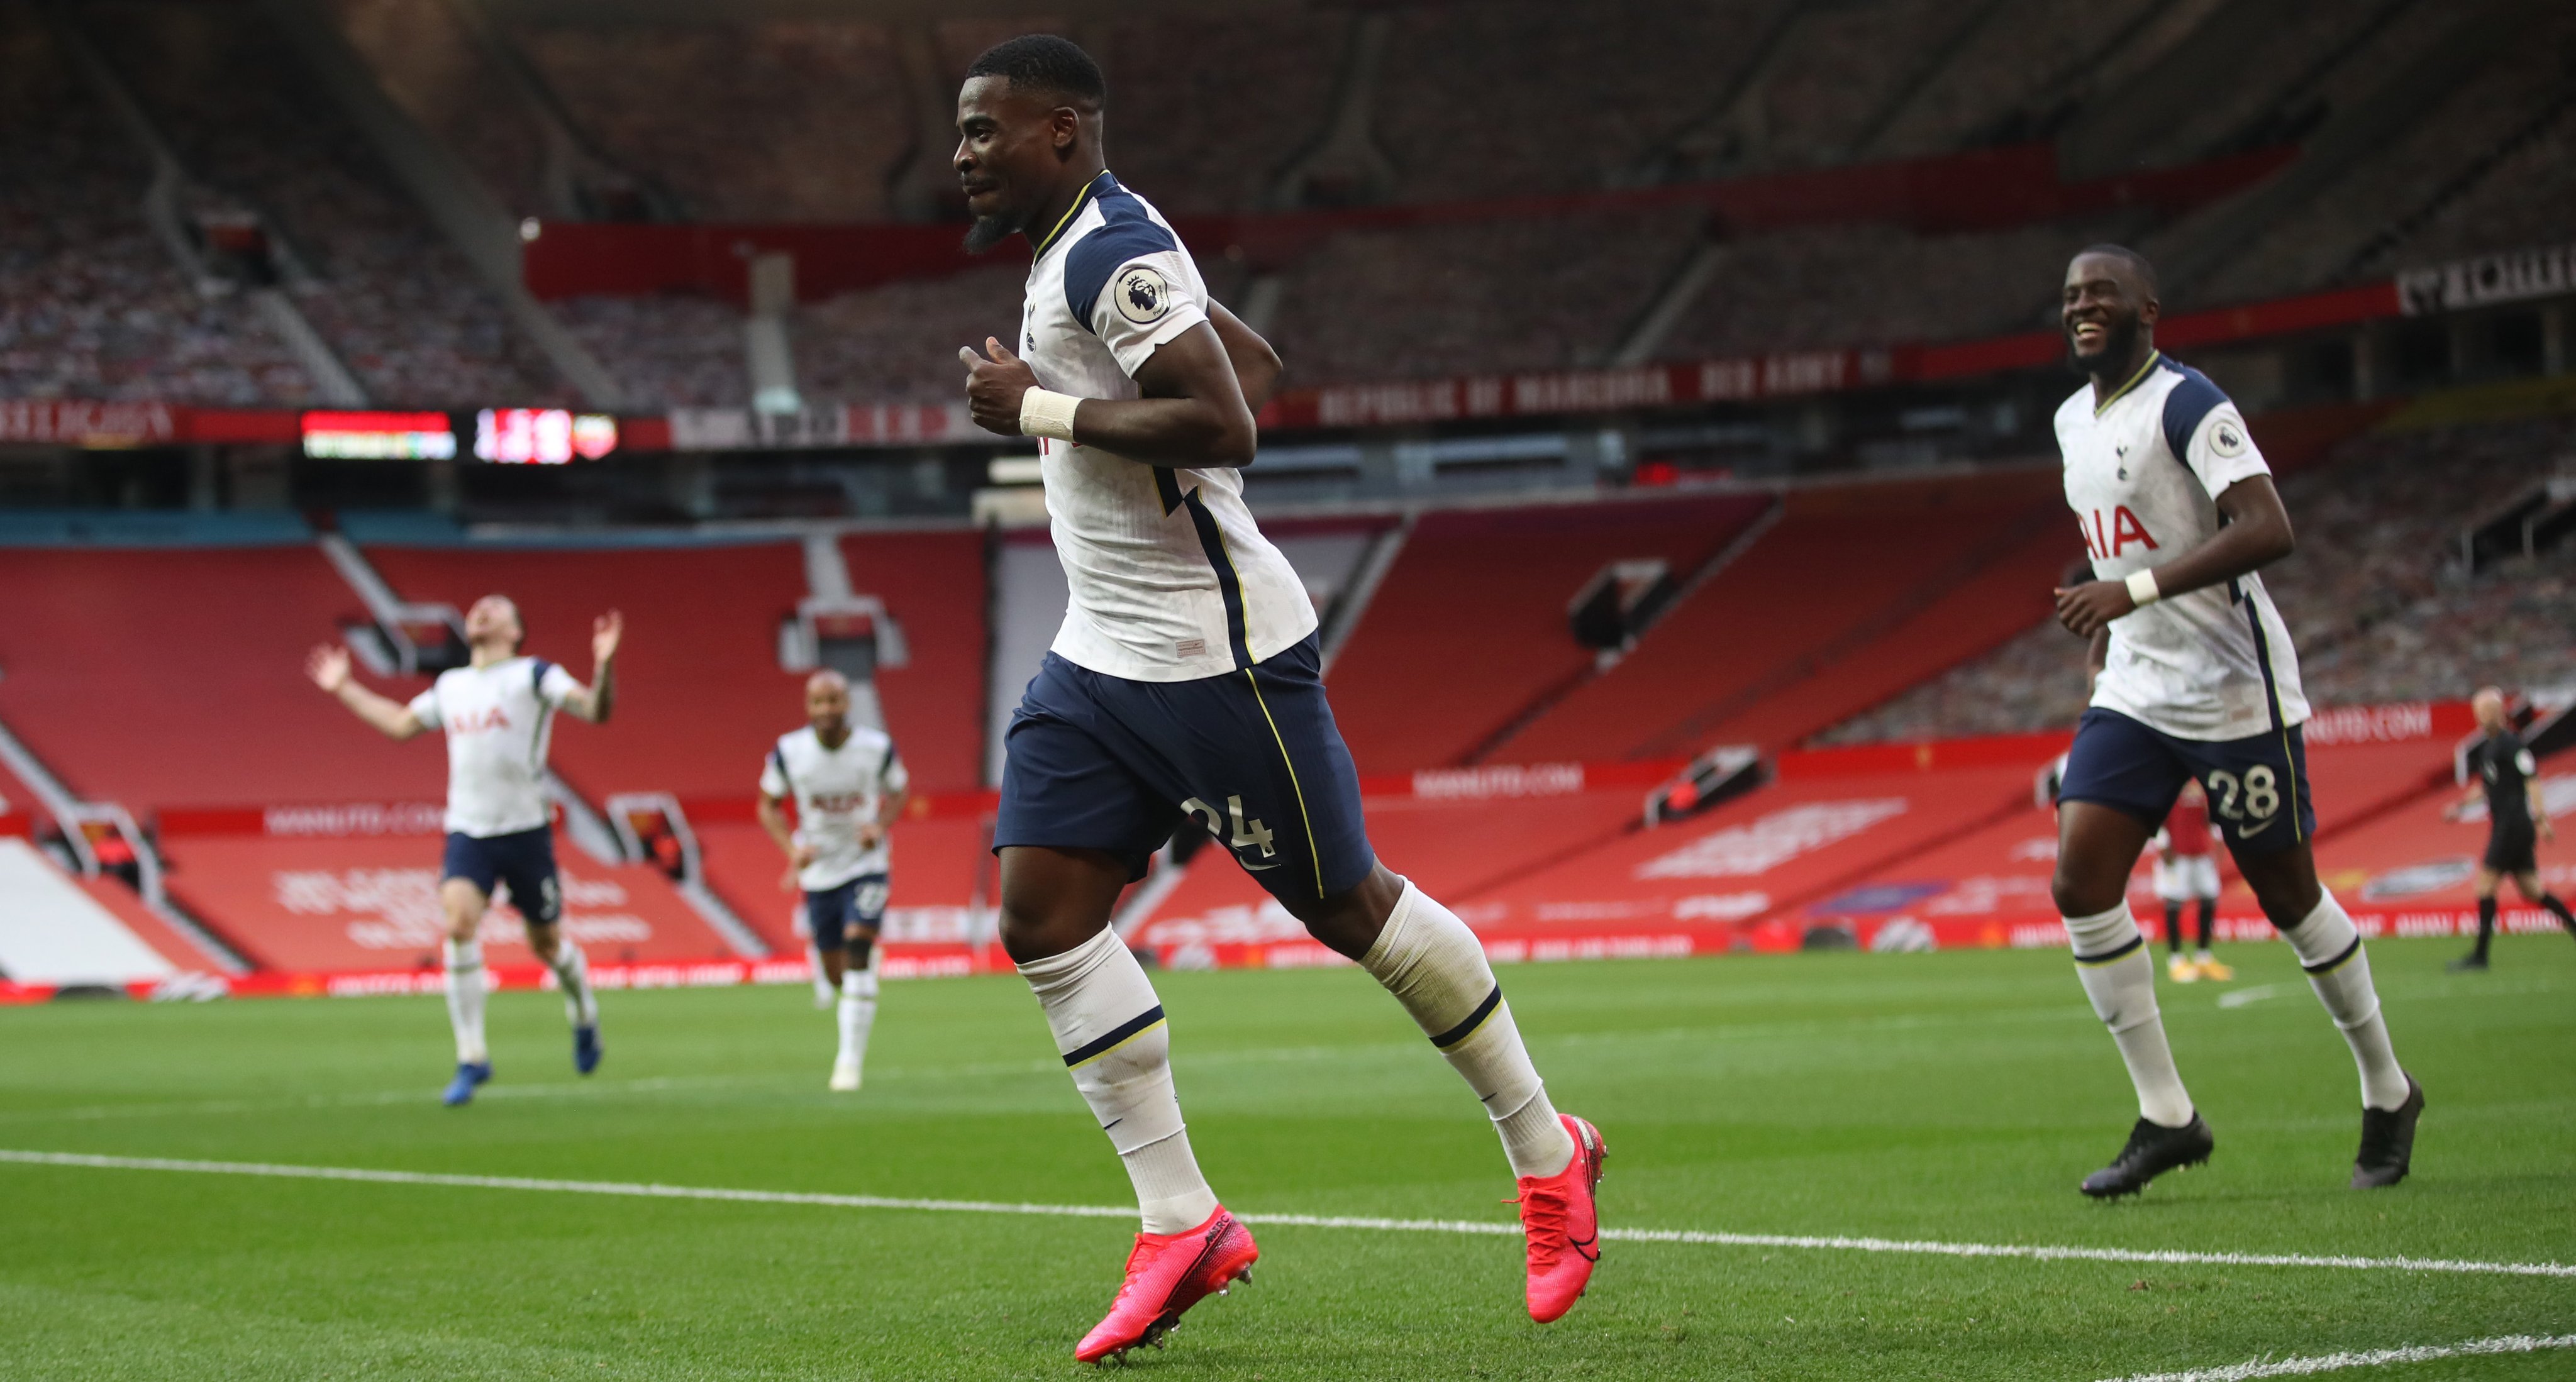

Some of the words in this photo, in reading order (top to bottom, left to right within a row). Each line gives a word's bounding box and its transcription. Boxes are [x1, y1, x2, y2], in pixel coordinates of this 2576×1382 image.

[1413, 763, 1584, 799] MANUTD.COM
[2208, 765, 2280, 820] 28
[1180, 794, 1276, 858] 24
